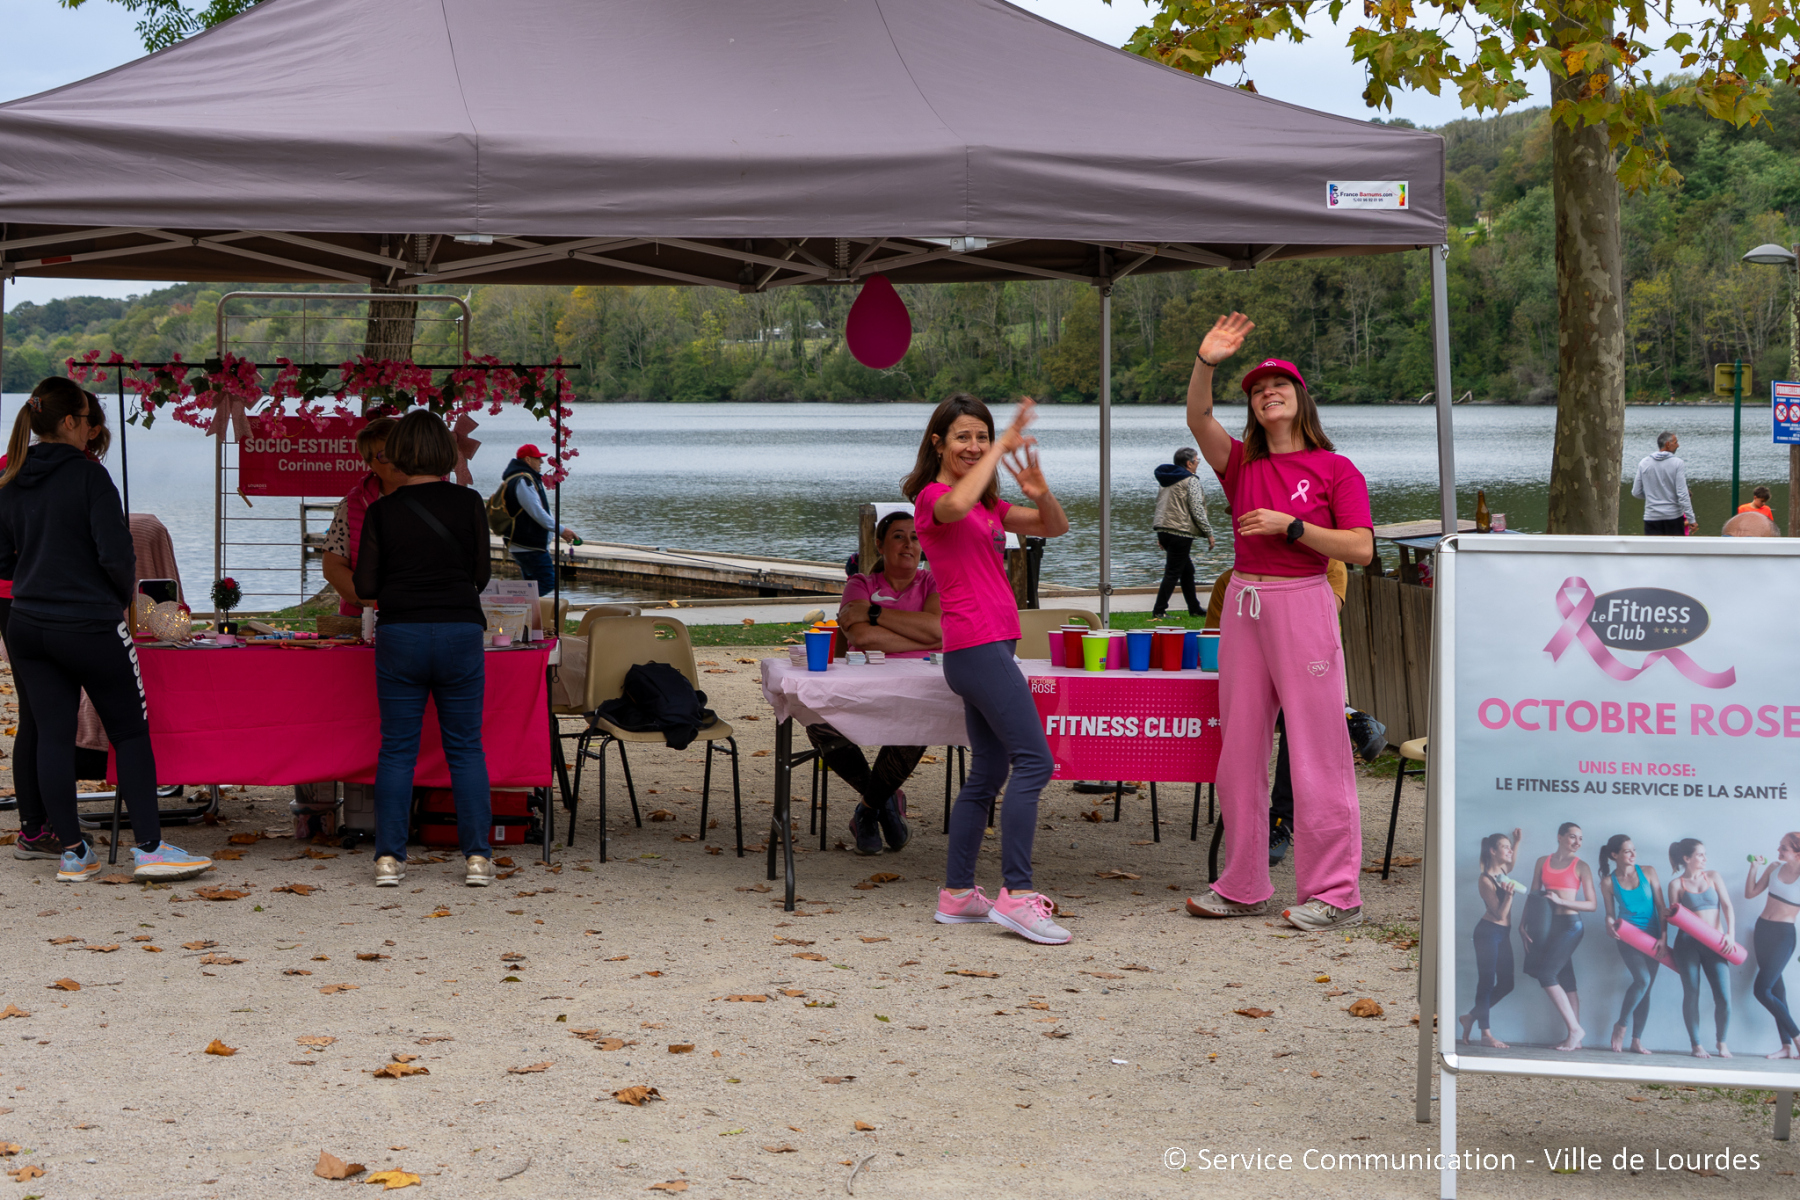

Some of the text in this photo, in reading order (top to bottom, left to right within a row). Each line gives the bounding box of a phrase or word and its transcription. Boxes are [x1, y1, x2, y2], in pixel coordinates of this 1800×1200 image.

[244, 436, 357, 454] SOCIO-ESTHÉT
[278, 458, 333, 472] Corinne
[1591, 599, 1691, 624] Le Fitness
[1606, 624, 1646, 641] Club
[1031, 683, 1057, 694] ROSE
[1477, 697, 1800, 738] OCTOBRE ROSE
[1046, 715, 1139, 737] FITNESS
[1144, 717, 1202, 738] CLUB
[1578, 760, 1696, 777] UNIS EN ROSE:
[1495, 777, 1788, 800] LE FITNESS AU SERVICE DE LA SANTÉ
[139, 854, 164, 862] HOKA
